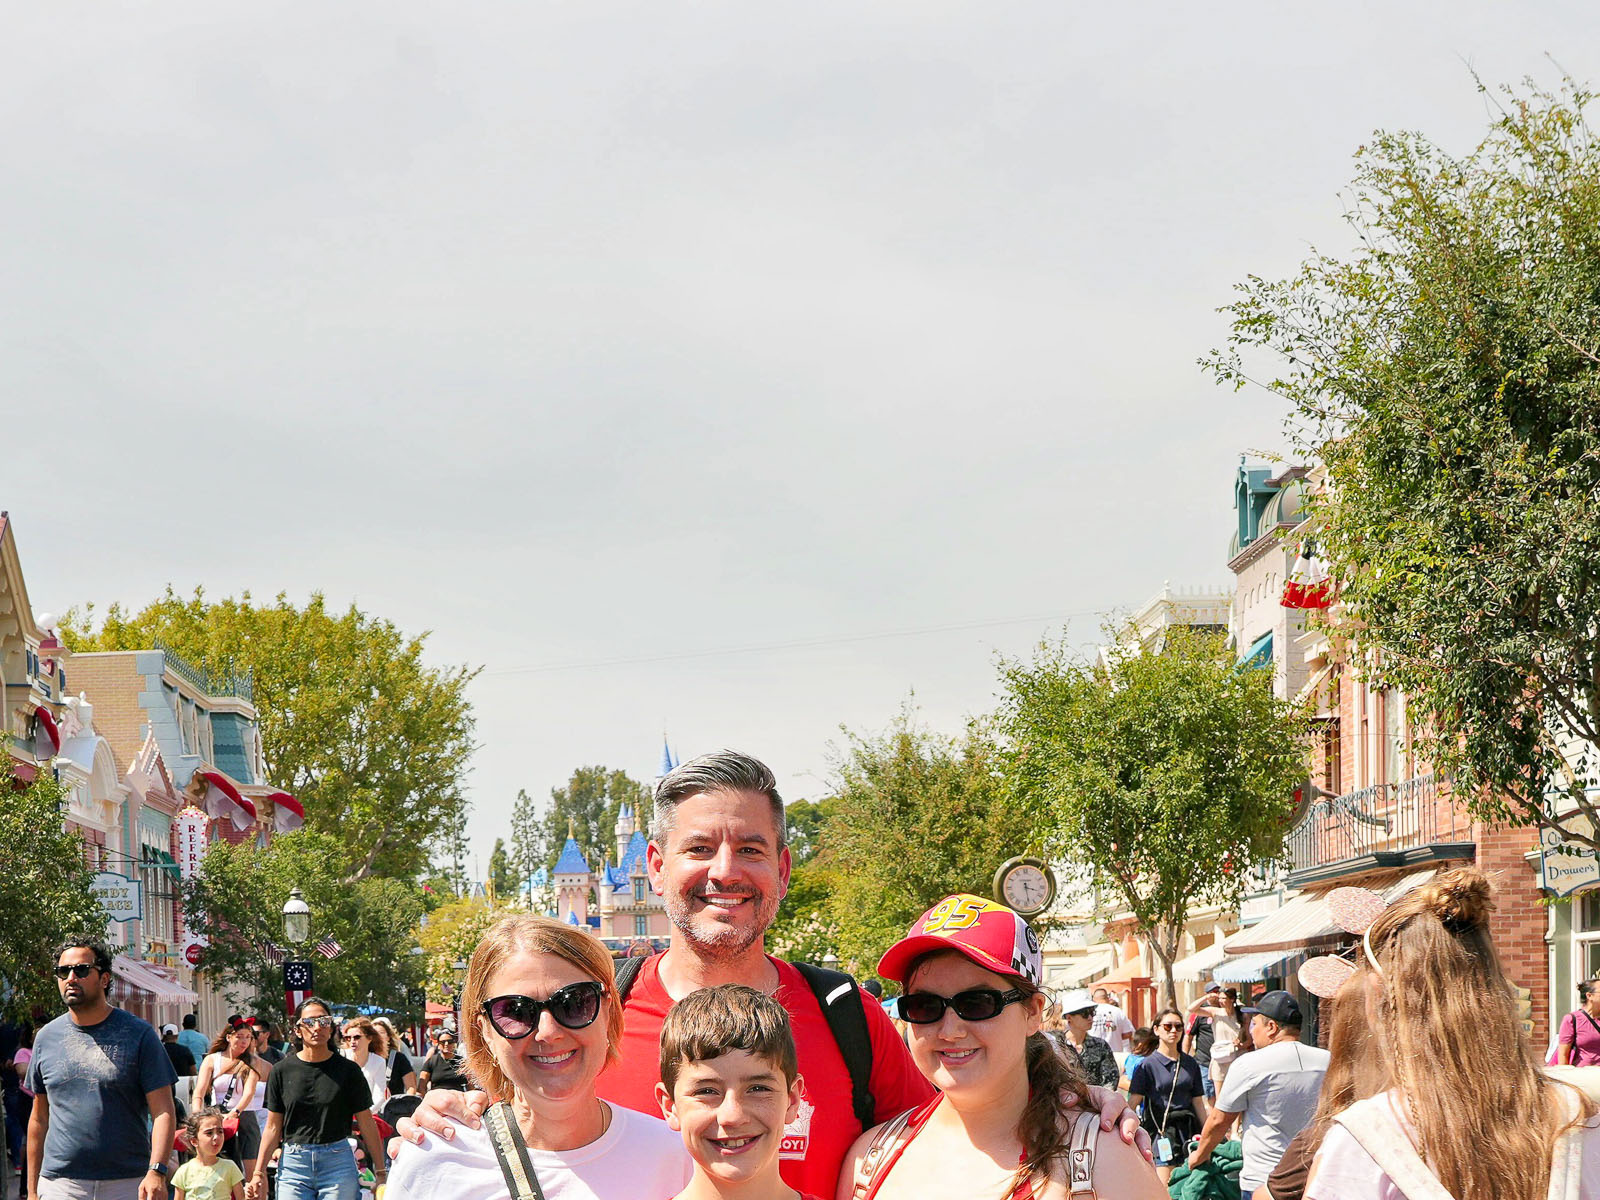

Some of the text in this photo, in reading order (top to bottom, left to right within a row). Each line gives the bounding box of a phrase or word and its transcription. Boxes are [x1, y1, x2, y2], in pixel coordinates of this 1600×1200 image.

[1548, 864, 1595, 880] Drawer's
[188, 824, 199, 939] REFRESS
[90, 887, 129, 898] ANDY
[922, 897, 988, 935] 95
[780, 1139, 804, 1150] OY!
